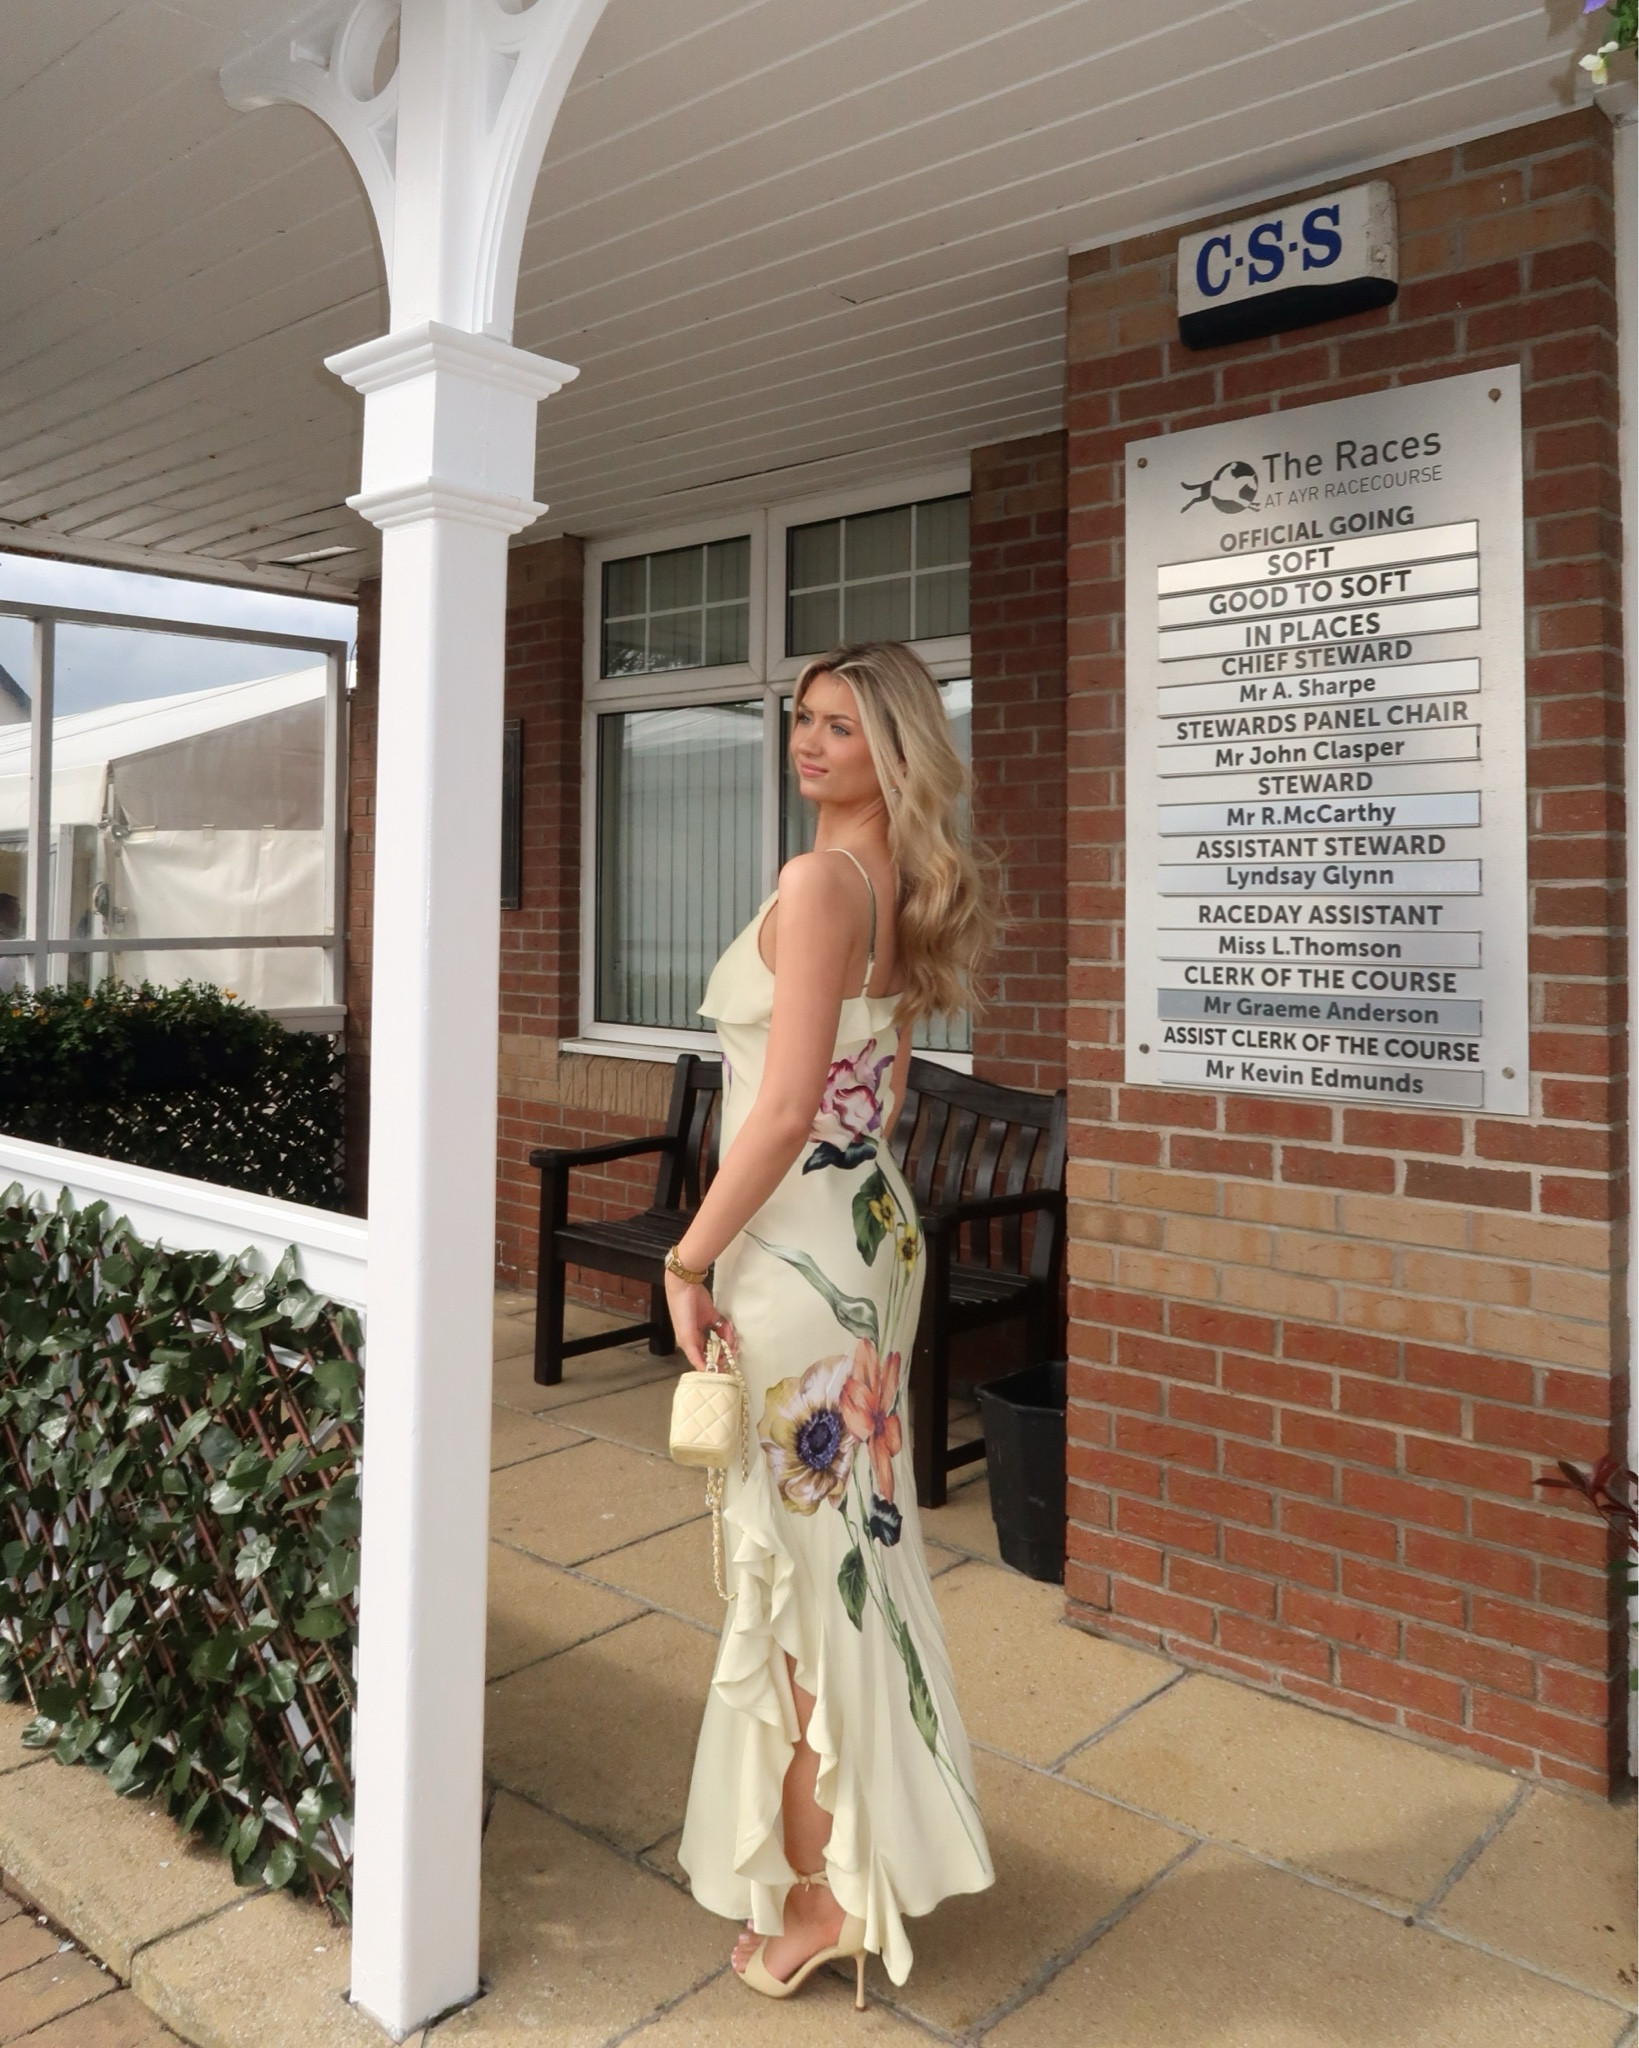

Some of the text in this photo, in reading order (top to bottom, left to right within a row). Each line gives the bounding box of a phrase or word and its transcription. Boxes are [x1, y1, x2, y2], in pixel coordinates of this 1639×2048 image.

[1262, 432, 1442, 484] The Races
[1264, 465, 1443, 508] AT AYR RACECOURSE
[1220, 505, 1415, 552] OFFICIAL GOING
[1268, 546, 1335, 576] SOFT
[1209, 570, 1412, 616] GOOD TO SOFT
[1245, 612, 1381, 648] IN PLACES
[1222, 639, 1412, 676] CHIEF STEWARD
[1240, 676, 1376, 702] Mr A. Sharpe
[1176, 701, 1468, 740] STEWARDS PANEL CHAIR
[1215, 737, 1405, 767] Mr John Clasper
[1258, 772, 1373, 795] STEWARD
[1227, 808, 1255, 826] Mr
[1196, 835, 1446, 859] ASSISTANT STEWARD
[1227, 865, 1394, 890] Lyndsay Glynn
[1199, 905, 1444, 925] RACEDAY ASSISTANT
[1218, 936, 1266, 955] Miss
[1184, 966, 1457, 993] CLERK OF THE COURSE
[1204, 997, 1439, 1024] Mr Graeme Anderson
[1164, 1027, 1480, 1062] ASSIST CLERK OF THE COURSE
[1205, 1060, 1424, 1094] Mr Kevin Edmunds
